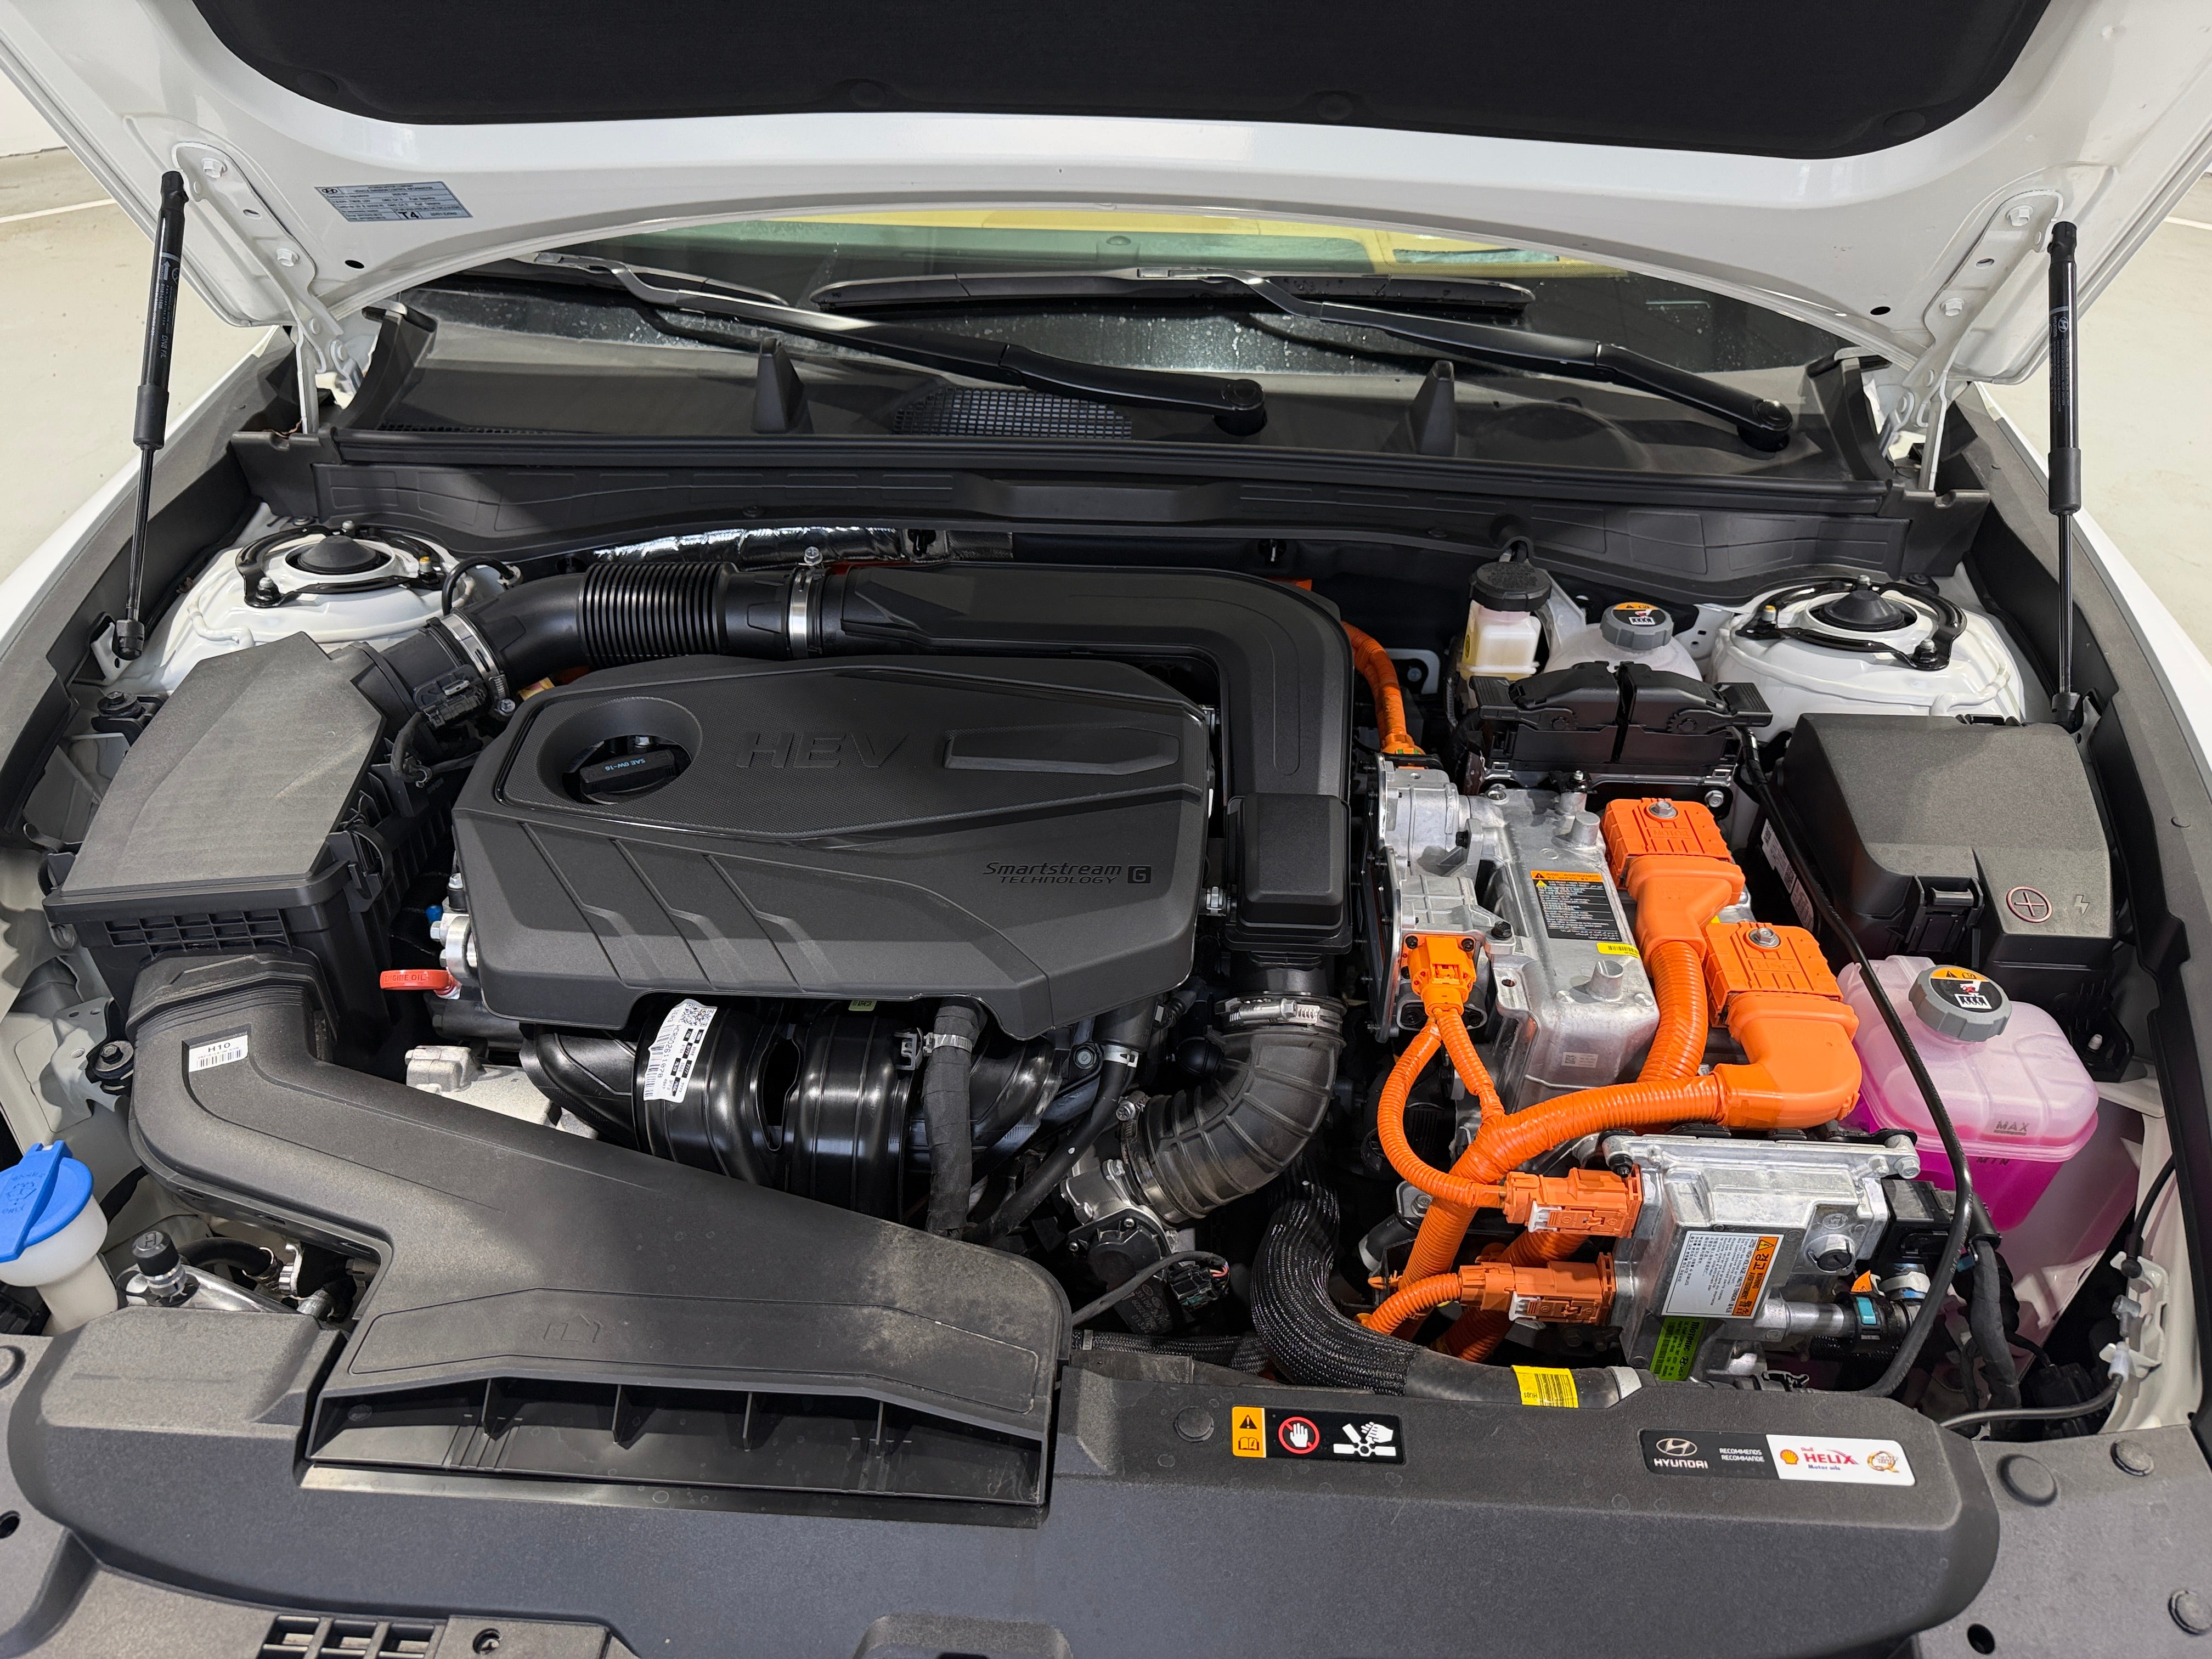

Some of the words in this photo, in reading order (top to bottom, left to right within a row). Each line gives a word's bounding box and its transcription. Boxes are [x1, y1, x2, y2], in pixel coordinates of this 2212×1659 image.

[398, 211, 419, 219] T4
[737, 732, 911, 768] HEV
[605, 761, 630, 771] 0W-16
[1653, 829, 1690, 837] MOTOR
[983, 862, 1122, 875] Smartstream
[998, 876, 1118, 884] TECHNOLOGY
[208, 1042, 230, 1053] H10
[1995, 1120, 2030, 1132] MAX
[1751, 1253, 1770, 1271] 경고
[1654, 1458, 1708, 1469] HYUNDAI
[1803, 1453, 1858, 1465] HELIX
